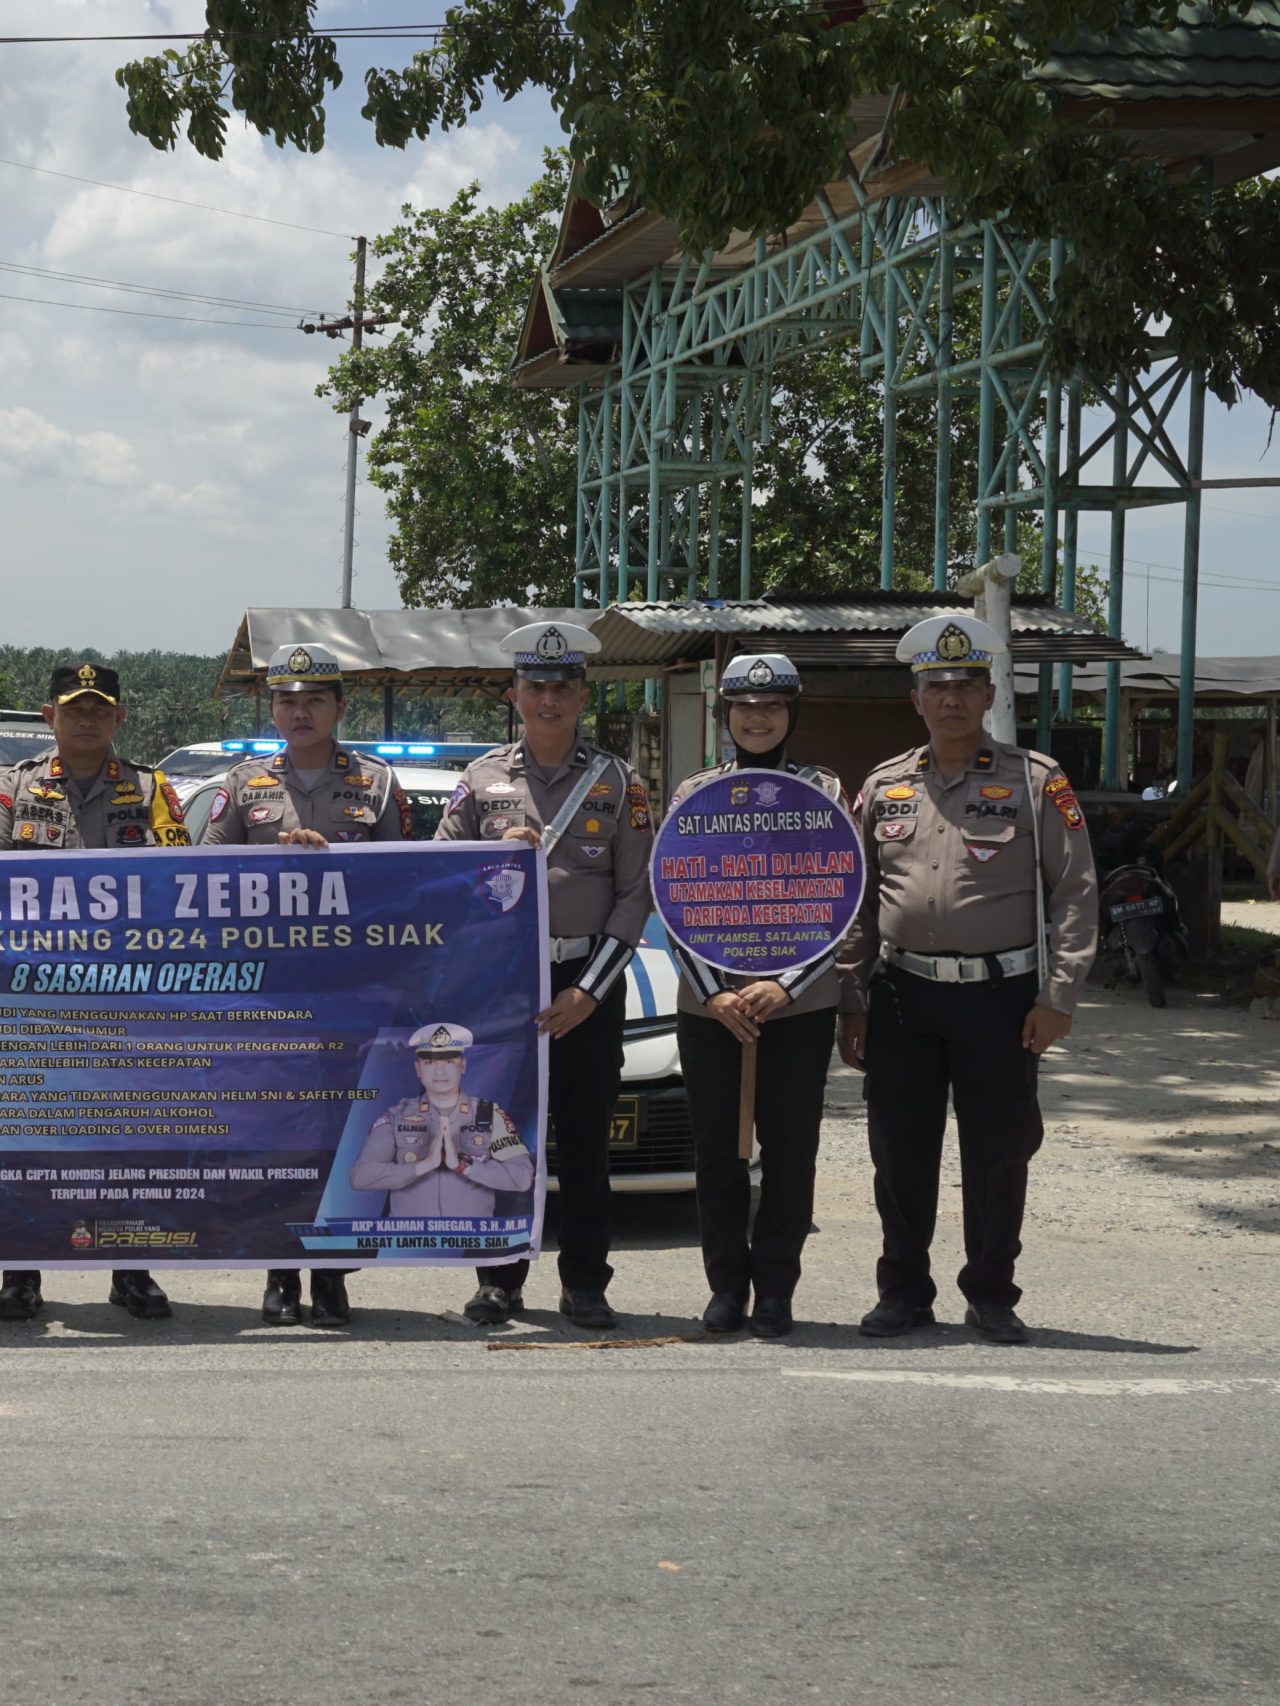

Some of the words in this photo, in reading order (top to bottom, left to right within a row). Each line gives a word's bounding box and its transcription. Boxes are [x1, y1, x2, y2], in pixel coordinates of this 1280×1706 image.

[332, 790, 378, 805] POLRI
[480, 799, 522, 813] DEDY
[875, 802, 918, 818] DODI
[965, 803, 1018, 819] POLRI
[677, 815, 702, 835] SAT
[704, 813, 751, 833] LANTAS
[754, 811, 801, 832] POLRES
[804, 810, 834, 830] SIAK
[661, 856, 707, 879] HATI
[721, 854, 767, 877] HATI
[771, 851, 854, 876] DIJALAN
[174, 871, 350, 919] ZEBRA
[669, 881, 744, 903] UTAMAKAN
[746, 878, 845, 900] KESELAMATAN
[683, 905, 750, 926] DARIPADA
[752, 903, 833, 924] KECEPATAN
[124, 926, 208, 951] 2024
[221, 924, 352, 950] POLRES
[365, 922, 446, 947] SIAK
[689, 933, 715, 945] UNIT
[716, 932, 762, 944] KAMSEL
[765, 931, 832, 942] SATLANTAS
[723, 947, 768, 958] POLRES
[770, 946, 797, 957] SIAK
[10, 963, 29, 993] 8
[33, 962, 151, 993] SASARAN
[156, 961, 266, 992] OPERASI
[19, 1008, 57, 1019] YANG
[60, 1009, 166, 1021] MENGGUNAKAN
[169, 1010, 188, 1021] HP
[191, 1010, 224, 1021] SAAT
[227, 1009, 314, 1021] BERKENDARA
[20, 1024, 82, 1035] DIBAWAH
[86, 1026, 128, 1036] UMUR
[50, 1040, 88, 1051] LEBIH
[91, 1040, 122, 1051] DARI
[124, 1041, 133, 1051] 1
[136, 1041, 184, 1051] ORANG
[187, 1042, 233, 1052] UNTUK
[236, 1041, 325, 1051] PENGENDARA
[328, 1041, 345, 1051] R2
[29, 1057, 90, 1068] MELEBIHI
[92, 1057, 134, 1068] BATAS
[136, 1057, 213, 1068] KECEPATAN
[9, 1074, 45, 1085] ARUS
[30, 1091, 67, 1102] YANG
[70, 1091, 110, 1101] TIDAK
[112, 1090, 218, 1102] MENGGUNAKAN
[221, 1090, 257, 1101] HELM
[260, 1090, 282, 1101] SNI
[285, 1091, 296, 1100] &
[298, 1090, 345, 1101] SAFETY
[347, 1089, 379, 1100] BELT
[28, 1108, 75, 1119] DALAM
[78, 1107, 150, 1118] PENGARUH
[153, 1107, 216, 1118] ALKOHOL
[23, 1124, 58, 1136] OVER
[60, 1124, 121, 1135] LOADING
[123, 1125, 134, 1135] &
[136, 1124, 172, 1135] OVER
[174, 1124, 230, 1135] DIMENSI
[25, 1169, 58, 1181] CIPTA
[61, 1168, 106, 1181] KONDISI
[107, 1168, 147, 1181] JELANG
[148, 1168, 201, 1180] PRESIDEN
[203, 1168, 226, 1180] DAN
[228, 1168, 265, 1180] WAKIL
[267, 1167, 319, 1180] PRESIDEN
[50, 1188, 98, 1200] TERPILIH
[99, 1188, 130, 1200] PADA
[132, 1187, 172, 1200] PEMILU
[175, 1187, 206, 1200] 2024
[351, 1220, 375, 1232] AKP
[376, 1219, 425, 1232] KALIMAN
[427, 1219, 476, 1233] SIREGAR,
[99, 1231, 197, 1245] PRESISI
[357, 1236, 393, 1249] KASAT
[396, 1236, 438, 1249] LANTAS
[440, 1236, 481, 1249] POLRES
[484, 1236, 510, 1248] SIAK
